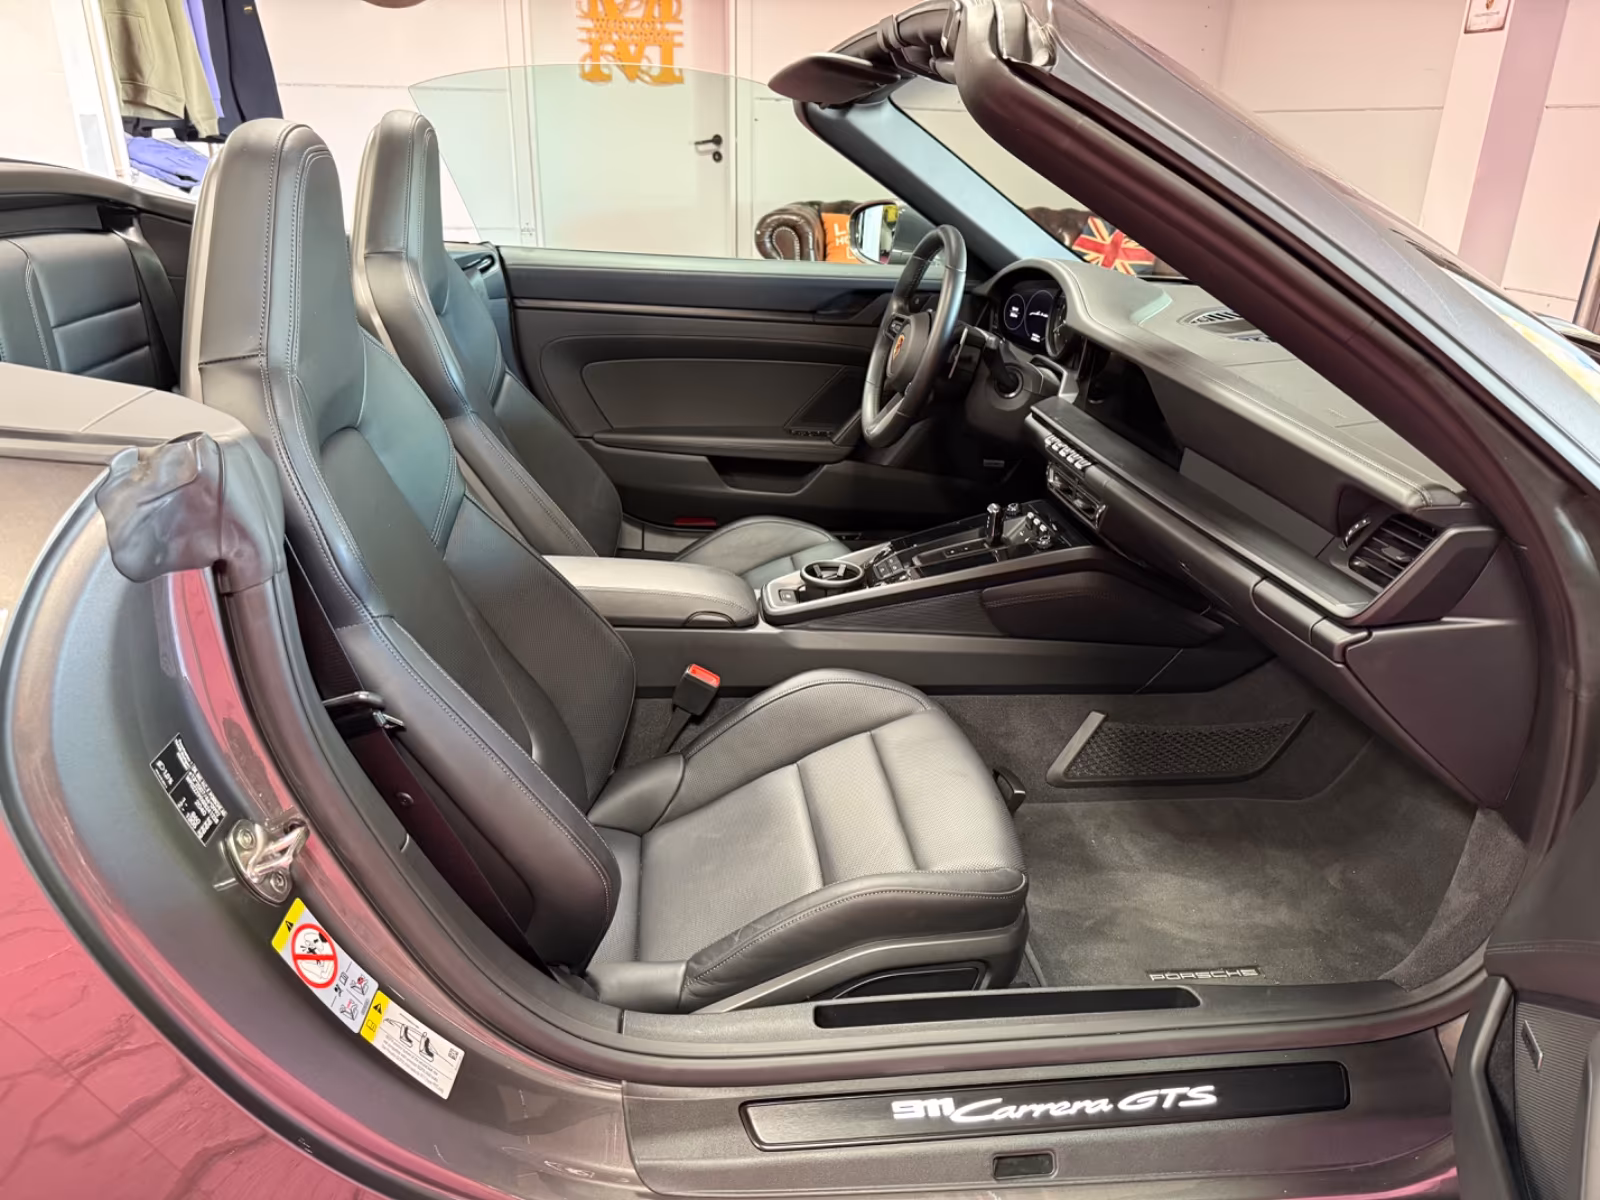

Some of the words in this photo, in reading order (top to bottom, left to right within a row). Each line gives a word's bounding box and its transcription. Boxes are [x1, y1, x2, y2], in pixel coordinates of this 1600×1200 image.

[1149, 968, 1259, 981] PORSCHE
[892, 1097, 955, 1120] 911
[949, 1097, 1114, 1123] Carrera
[1117, 1085, 1218, 1111] GTS
